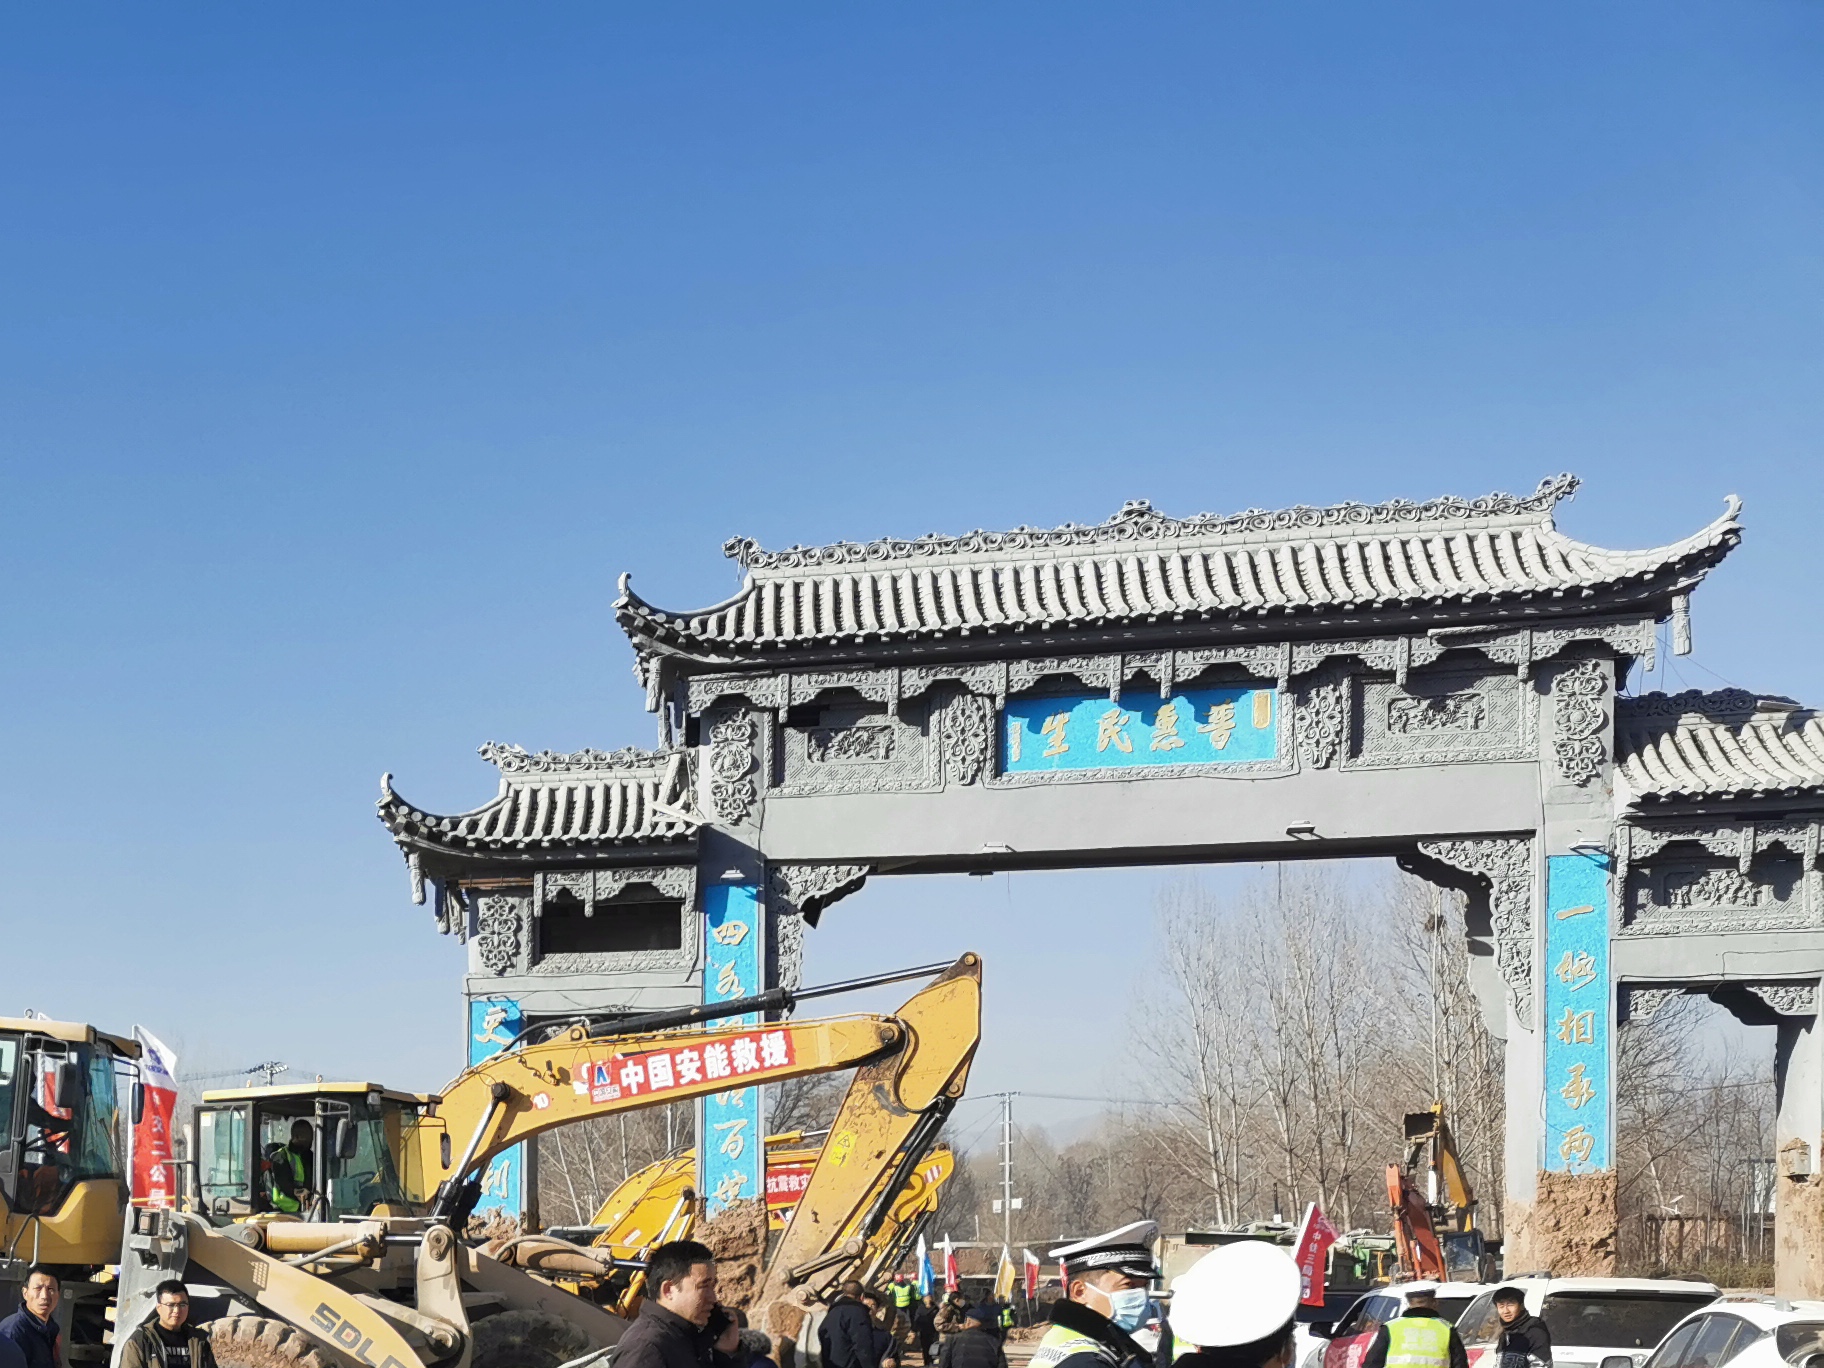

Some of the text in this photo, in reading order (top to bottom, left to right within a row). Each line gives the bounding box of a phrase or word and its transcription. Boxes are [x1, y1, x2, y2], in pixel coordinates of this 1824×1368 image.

[619, 1029, 790, 1095] 中国安能救援
